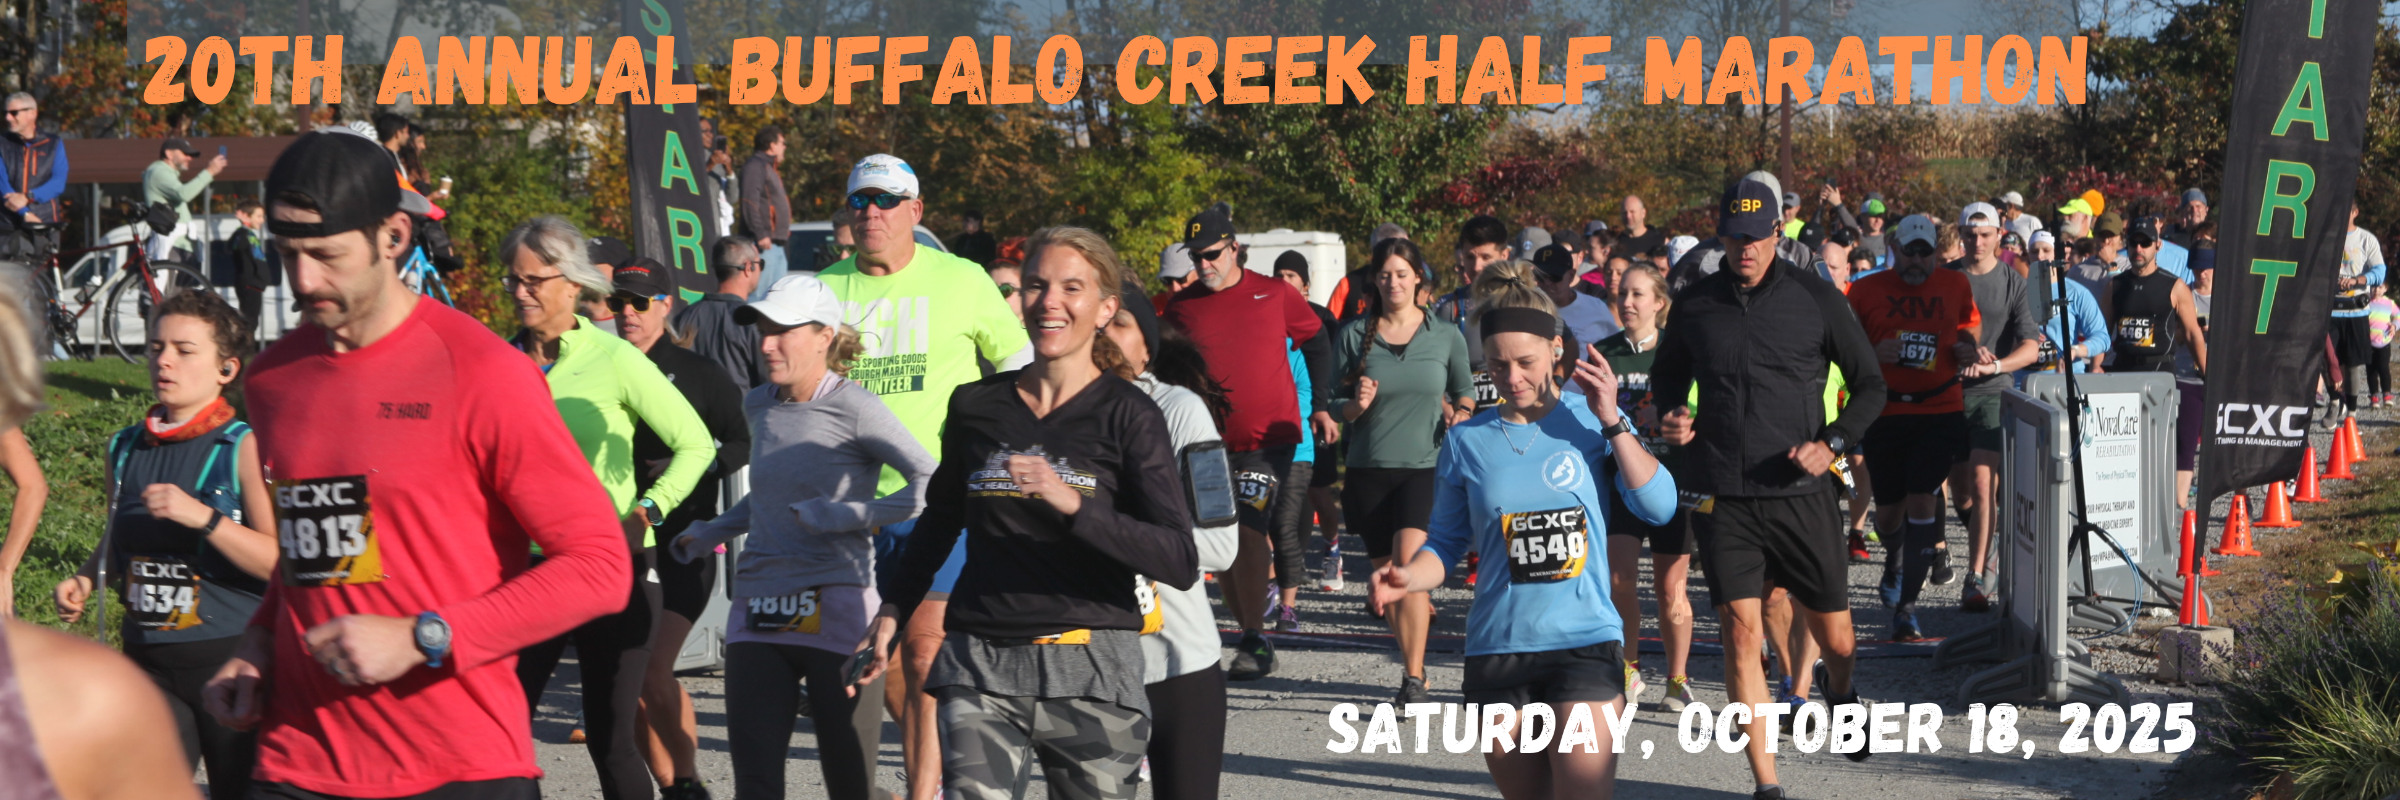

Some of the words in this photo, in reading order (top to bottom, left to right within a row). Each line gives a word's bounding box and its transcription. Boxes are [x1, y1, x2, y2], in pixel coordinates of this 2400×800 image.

[1730, 199, 1762, 213] CBP
[1191, 223, 1201, 238] P
[2122, 318, 2150, 326] GCXC
[1901, 332, 1935, 344] GCXC
[2120, 327, 2150, 339] 4461
[862, 355, 900, 369] SPORTING
[901, 353, 927, 365] GOODS
[850, 367, 881, 380] SBURGH
[881, 364, 927, 377] MARATHON
[2095, 406, 2139, 437] NovaCare
[2244, 437, 2303, 447] MANAGEMENT
[2096, 444, 2137, 458] REHABILITATION
[276, 482, 356, 509] GCXC
[2112, 500, 2128, 511] THERAPY
[2127, 500, 2135, 509] AND
[1511, 510, 1582, 532] GCXC
[280, 513, 368, 560] 4813
[1510, 531, 1585, 565] 4540
[131, 561, 188, 580] GCXC
[128, 583, 195, 615] 4634
